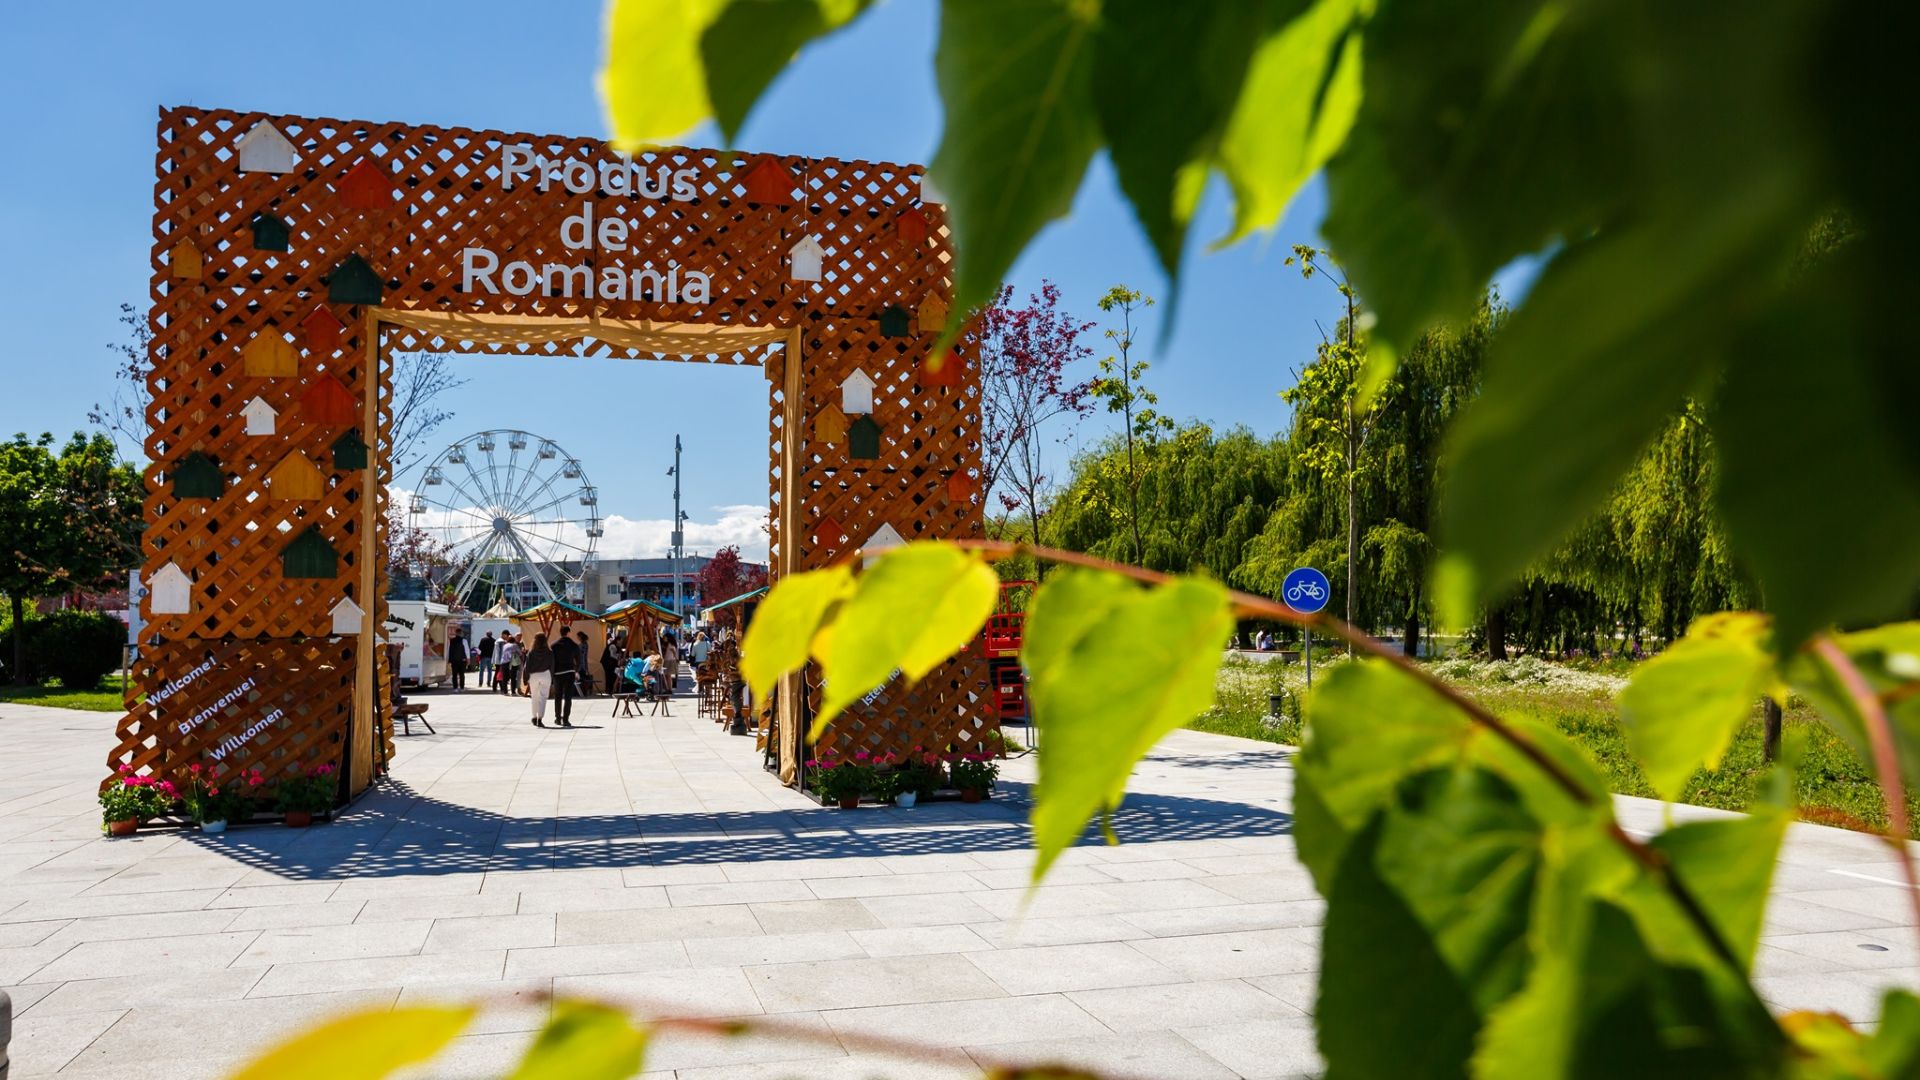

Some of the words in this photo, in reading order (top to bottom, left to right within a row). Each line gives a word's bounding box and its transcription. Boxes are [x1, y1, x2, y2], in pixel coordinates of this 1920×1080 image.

[502, 144, 697, 202] Produs
[560, 201, 629, 250] de
[462, 247, 711, 305] Romania
[145, 656, 218, 707] Wellcome!
